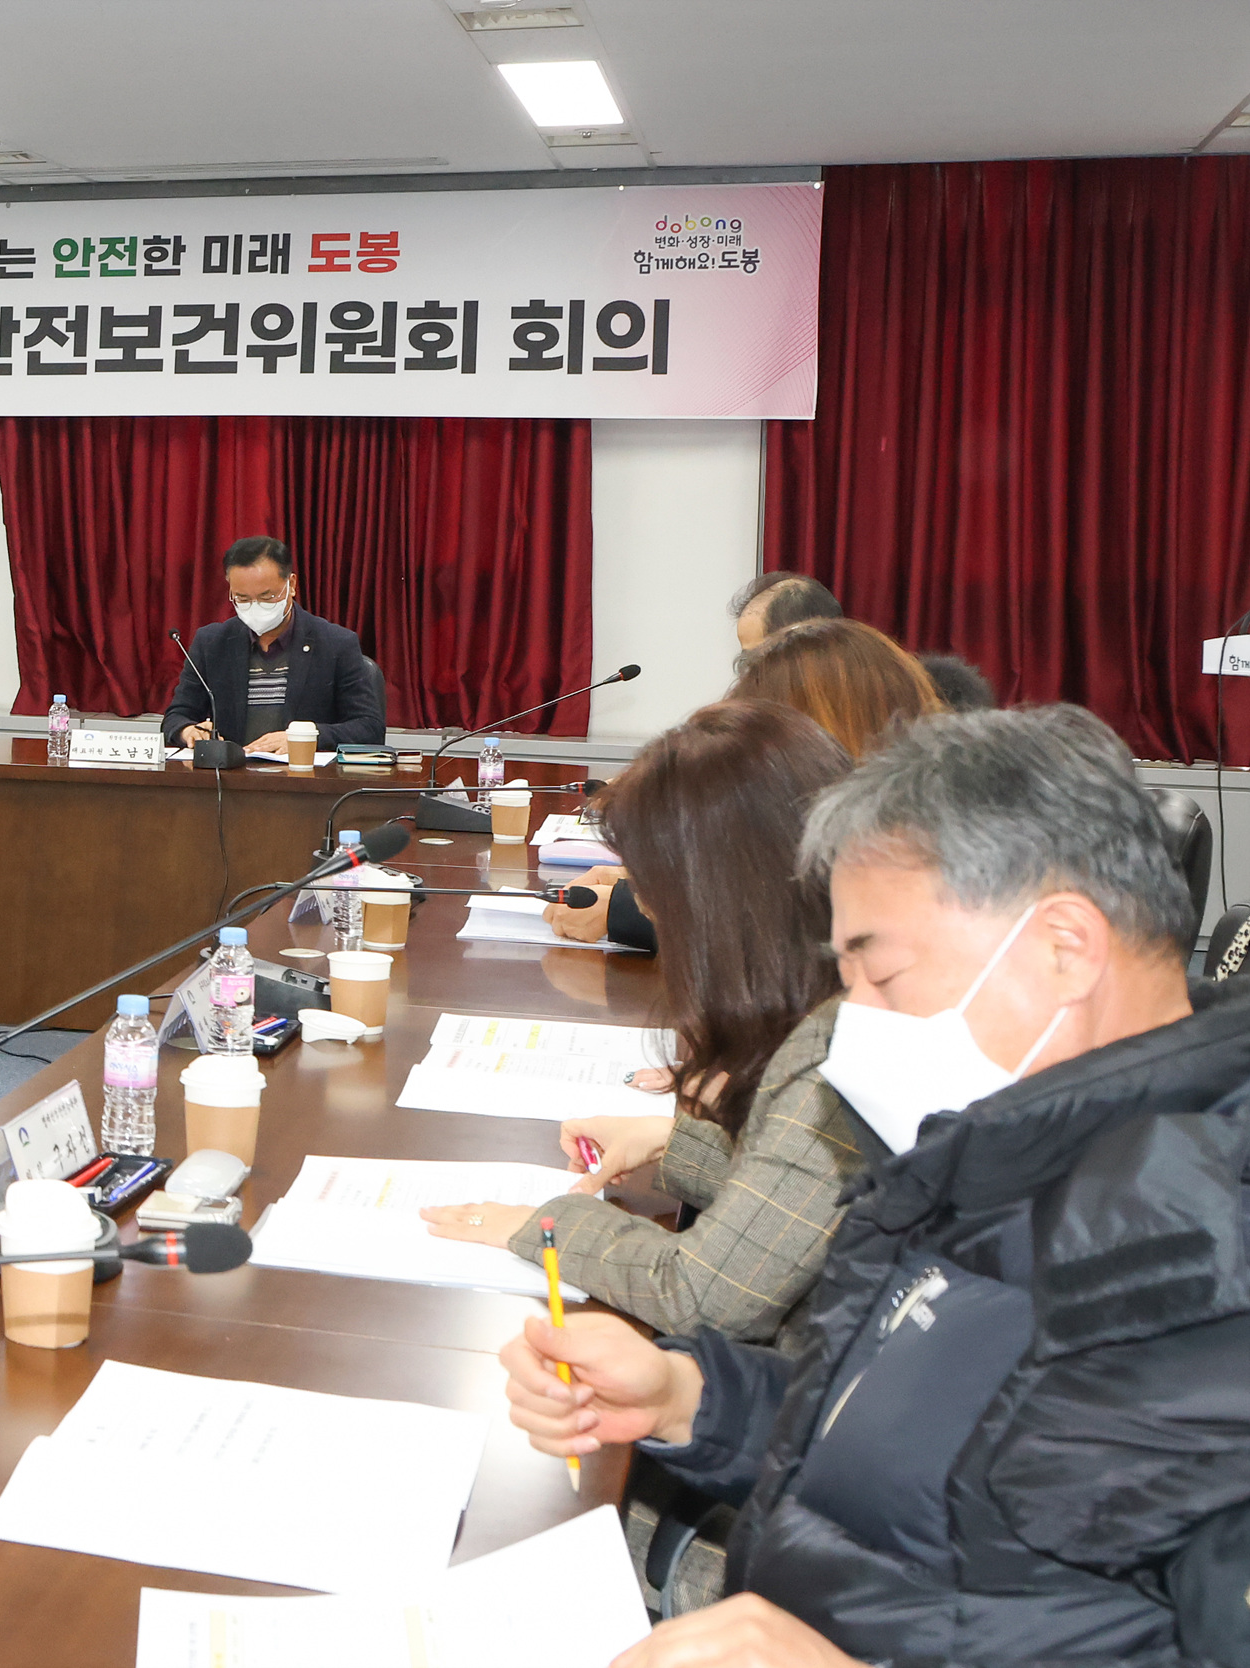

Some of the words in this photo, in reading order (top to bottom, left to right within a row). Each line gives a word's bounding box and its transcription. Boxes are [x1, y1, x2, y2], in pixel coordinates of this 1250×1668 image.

[655, 215, 742, 233] dobong
[52, 234, 187, 279] 안전한
[202, 232, 292, 276] 미래
[308, 231, 401, 274] 도봉
[508, 299, 670, 375] 회의
